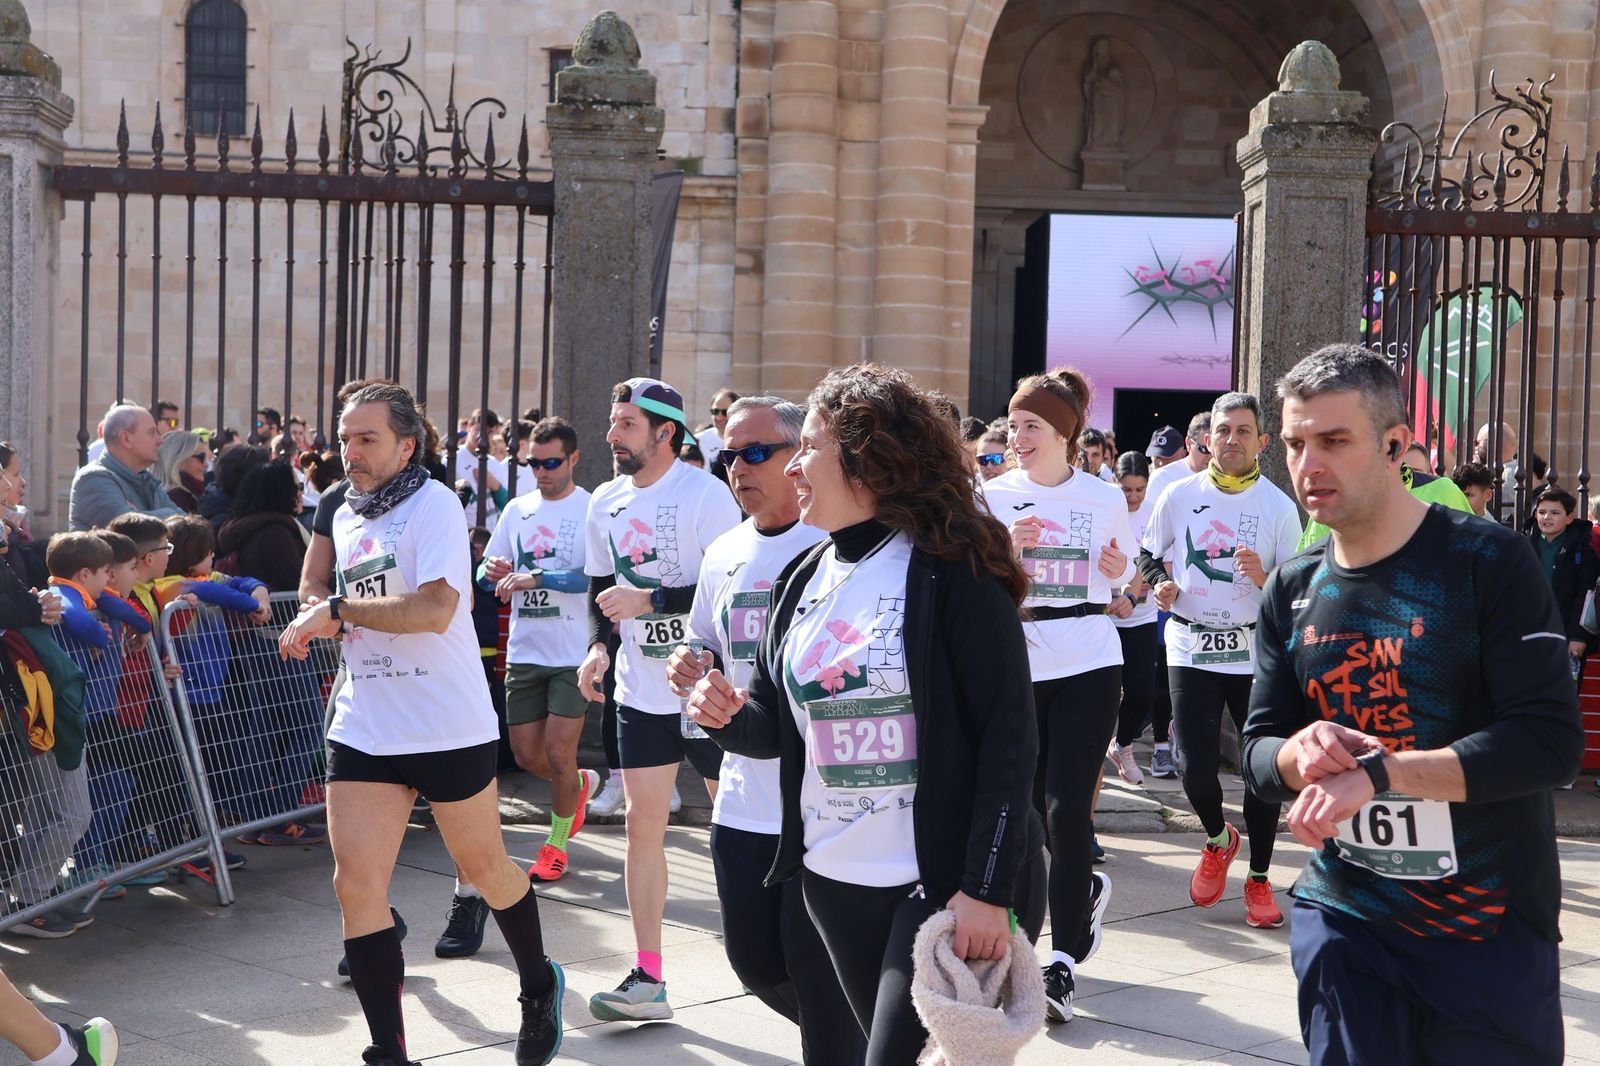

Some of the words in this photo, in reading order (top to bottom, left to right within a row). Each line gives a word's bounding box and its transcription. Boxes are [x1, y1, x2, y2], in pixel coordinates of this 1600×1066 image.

[355, 573, 387, 598] 257
[1034, 560, 1075, 584] 511
[523, 591, 549, 606] 242
[645, 618, 685, 644] 268
[744, 609, 767, 640] 6
[1201, 632, 1239, 651] 263
[1346, 637, 1404, 671] SAN
[1367, 668, 1409, 699] SIL
[1352, 703, 1414, 732] VES
[832, 718, 905, 762] 529
